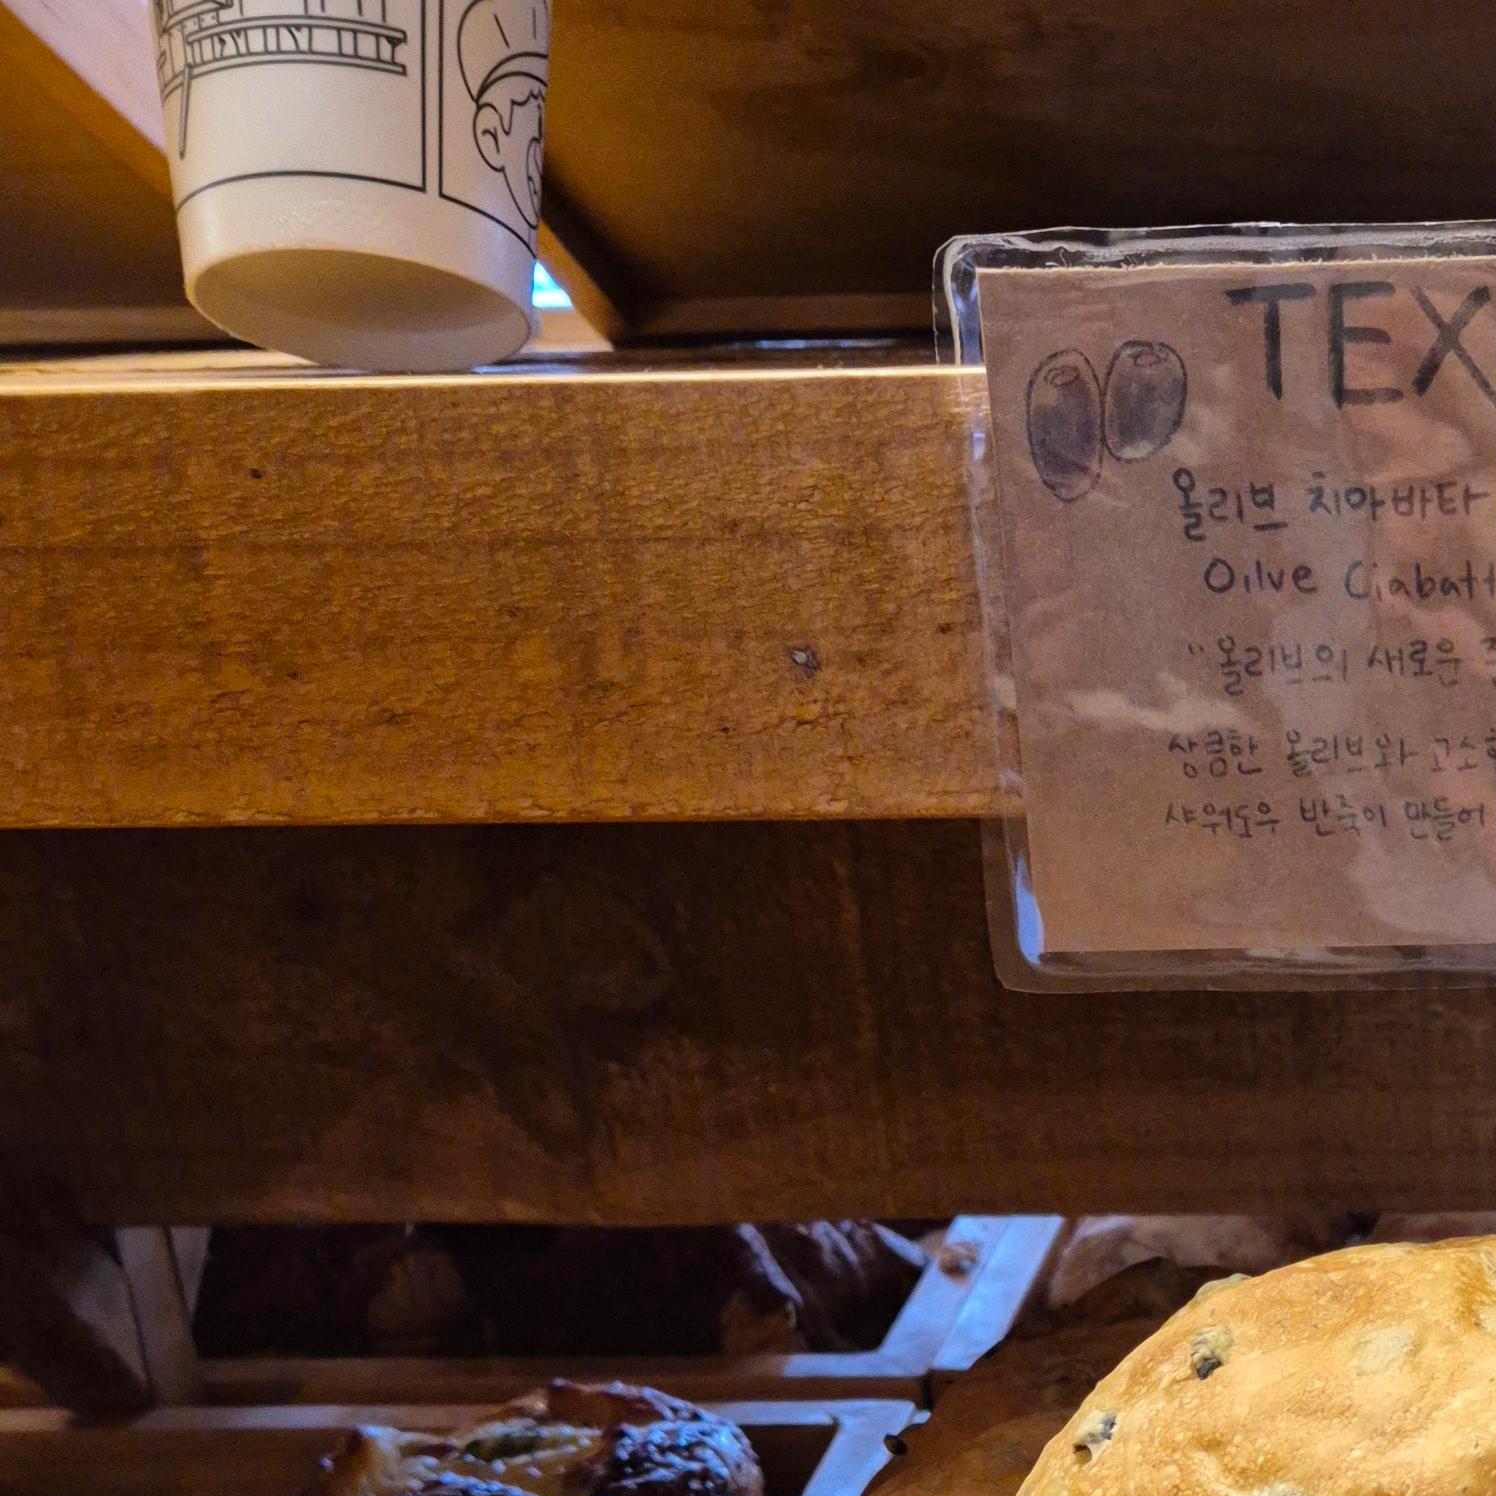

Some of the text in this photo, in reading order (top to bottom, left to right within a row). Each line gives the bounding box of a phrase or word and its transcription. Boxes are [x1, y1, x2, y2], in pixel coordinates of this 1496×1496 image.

[1172, 467, 1490, 541] 올리브 치아바타
[1366, 637, 1463, 687] 새로운
[1168, 729, 1263, 778] 상큼한
[1286, 729, 1418, 777] 올리브와
[1301, 794, 1387, 837] 반죽이
